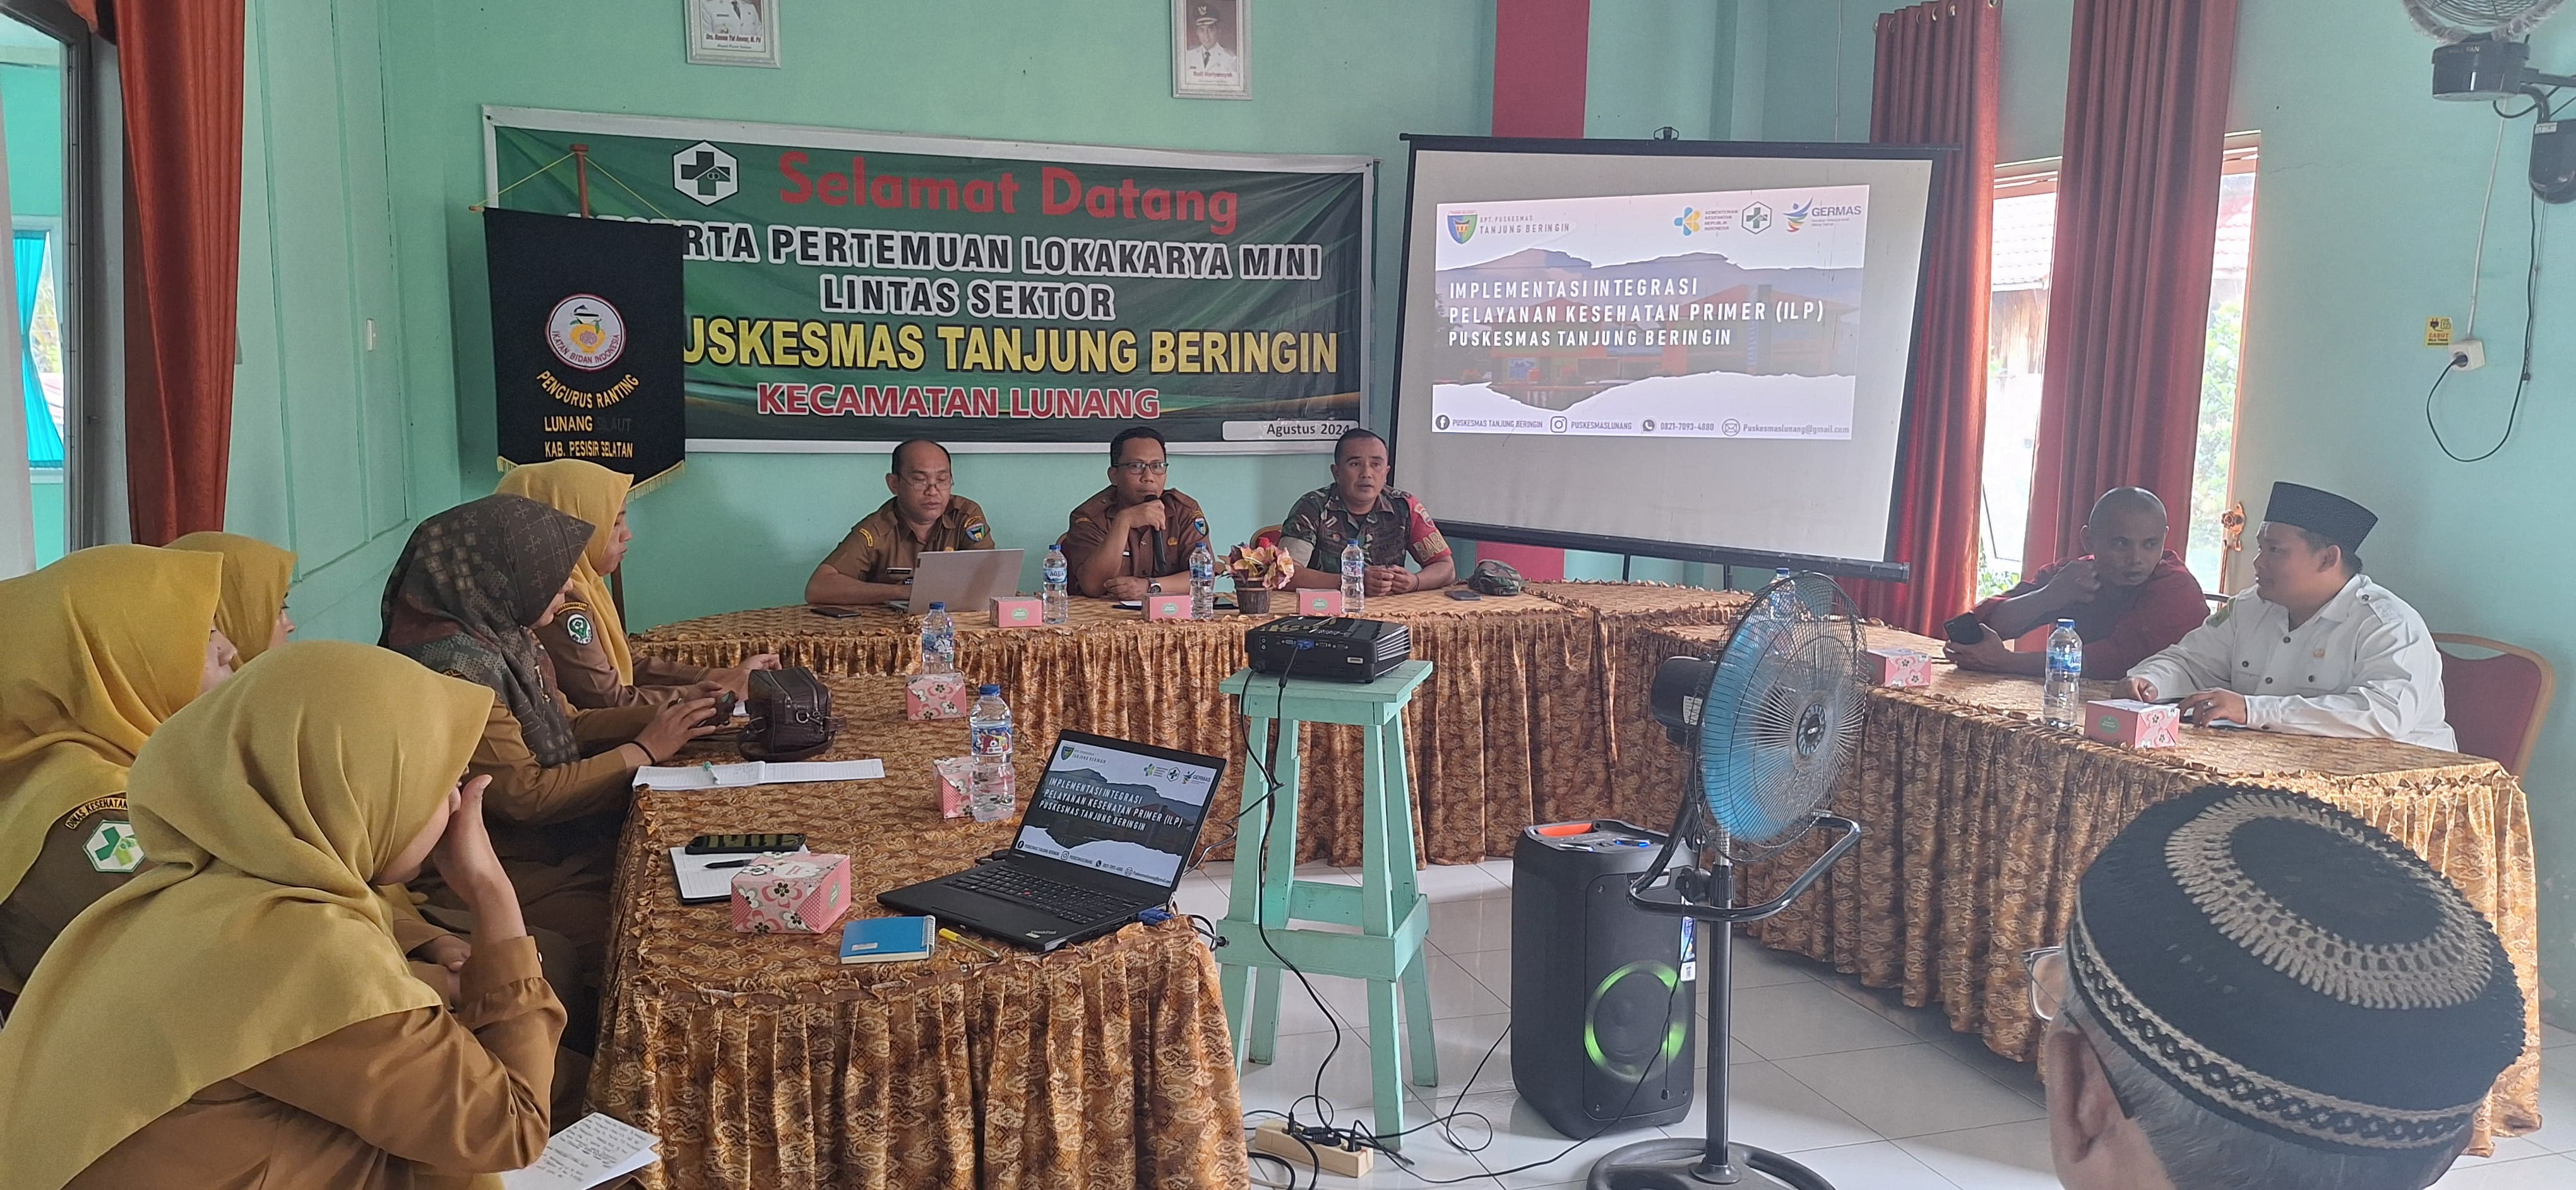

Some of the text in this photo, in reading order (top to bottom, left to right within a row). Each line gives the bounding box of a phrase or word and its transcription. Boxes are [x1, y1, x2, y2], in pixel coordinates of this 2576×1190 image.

[779, 151, 1237, 235] Selamat Datang
[1811, 206, 1861, 217] GERMAS
[1480, 223, 1570, 235] TANJUNG BERINGIN
[771, 225, 1010, 272] PERTEMUAN
[1023, 238, 1230, 279] LOKAKARYA
[1242, 244, 1321, 279] MINI
[823, 275, 1115, 320] LINTAS SEKTOR
[1450, 278, 1697, 299] IMPLEMENTASI INTEGRASI
[1449, 300, 1823, 323] PELAYANAN KESEHATAN PRIMER (ILP)
[552, 330, 620, 364] IKATAN BIDAN INDONESIA
[684, 317, 1337, 374] USKESMAS TANJUNG BERINGIN
[1448, 328, 1731, 347] PUSKESMAS TANJUNG BERINGIN
[537, 371, 640, 409] PENGURUS RANTING
[759, 384, 1160, 418] KECAMATAN LUNANG
[544, 416, 593, 431] LUNANG
[1267, 423, 1315, 437] Agustus
[1571, 421, 1632, 430] PUSKESMASLUNANG
[1743, 424, 1849, 434] Puskesmaslunang@gmail.com
[545, 441, 633, 458] KAB. PESISIR SELATAN
[1049, 777, 1143, 805] IMPLEMENTASI INTEGRASI
[67, 809, 86, 828] DINAS
[1039, 800, 1146, 831] PUSKESMAS TANJUNG BERINGIN
[1044, 789, 1183, 828] PELAYANAN KESEHATAN PRIMER (ILP)
